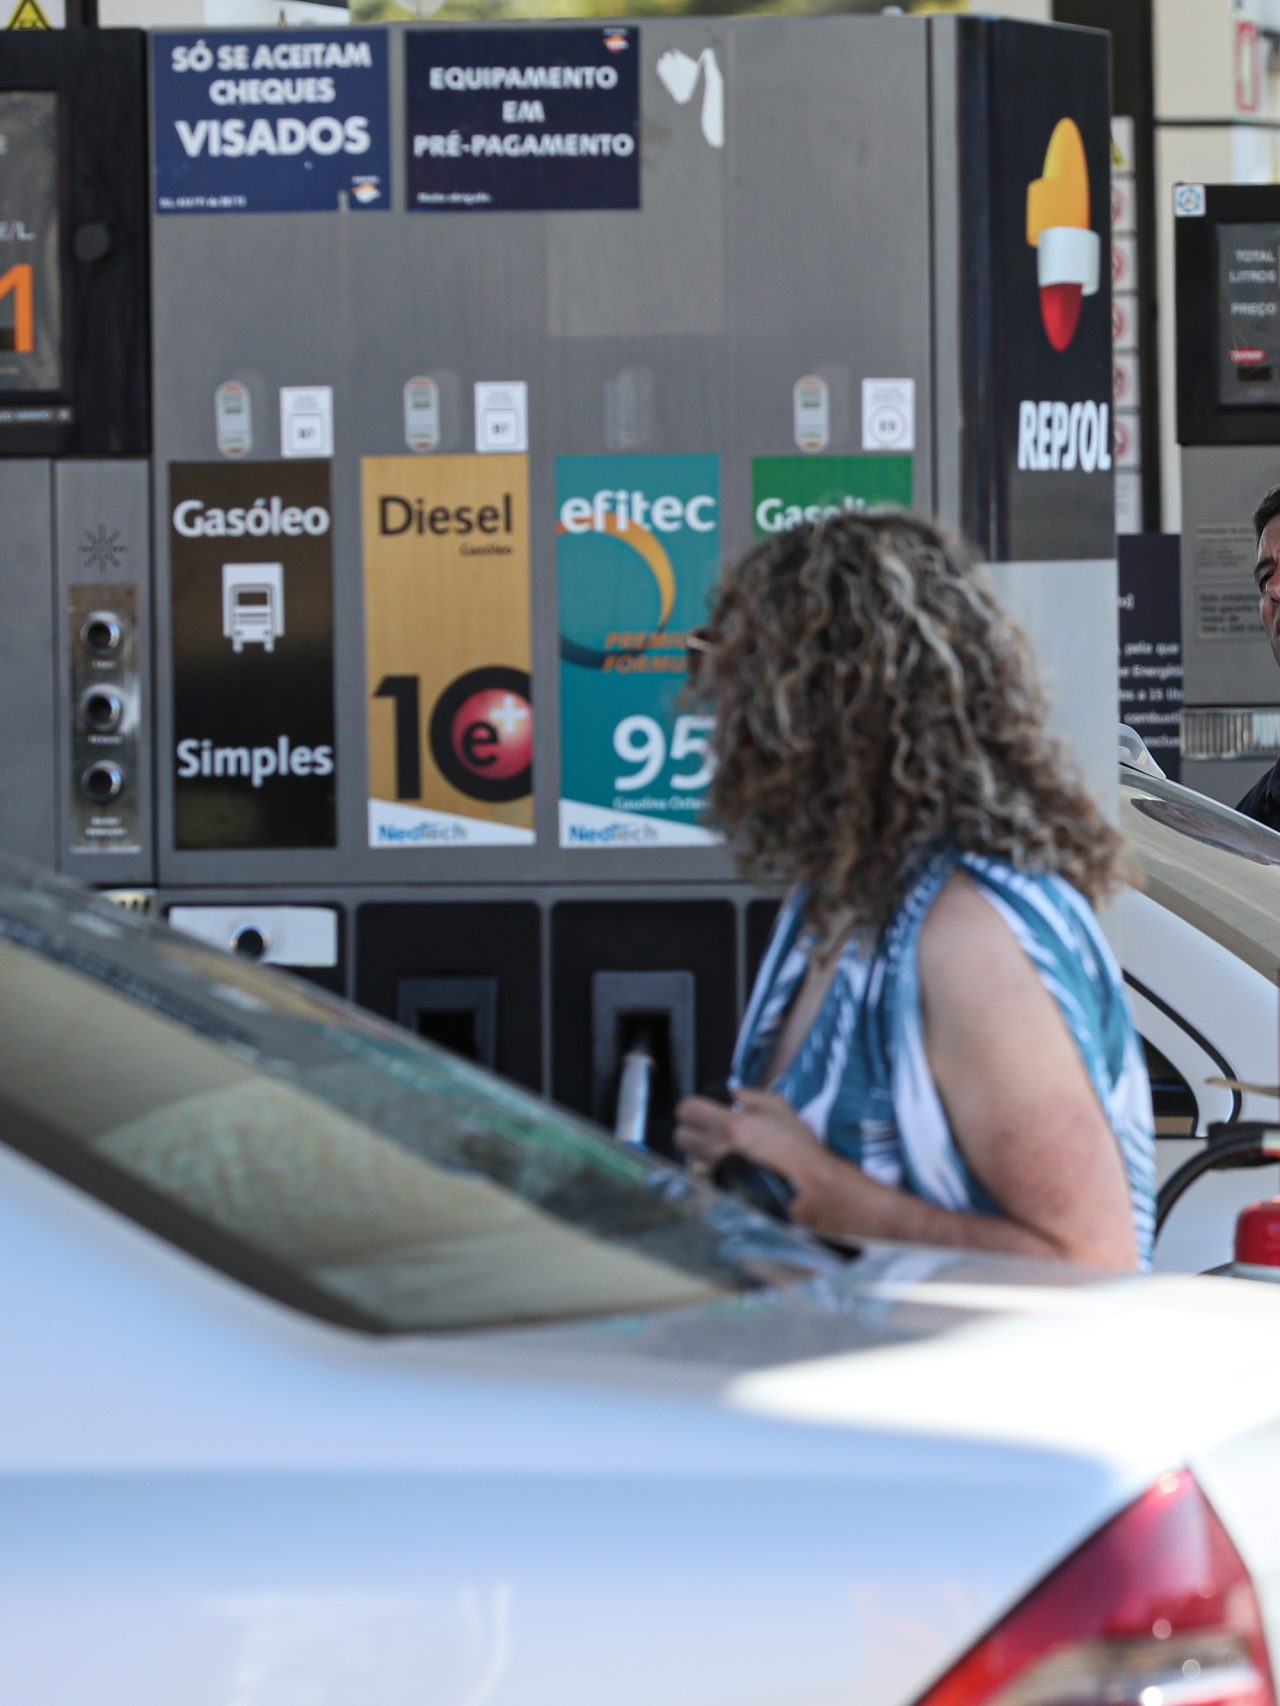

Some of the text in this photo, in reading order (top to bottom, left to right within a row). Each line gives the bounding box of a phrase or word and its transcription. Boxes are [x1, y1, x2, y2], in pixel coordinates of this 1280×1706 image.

[171, 39, 372, 72] SÓ SE ACEITAM
[209, 77, 336, 105] CHEQUES
[429, 66, 619, 91] EQUIPAMENTO
[502, 100, 546, 123] EM
[174, 116, 371, 157] VISADOS
[413, 130, 635, 157] PRÉ-PAGAMENTO
[1235, 249, 1275, 263] TOTAL
[1229, 270, 1277, 284] LITROS
[1230, 302, 1278, 317] PREÇO
[1017, 400, 1111, 472] REPSOL
[172, 496, 331, 538] Gasóleo
[378, 492, 514, 537] Diesel
[560, 489, 716, 534] efitec
[176, 735, 334, 788] Simples
[613, 715, 719, 791] 95
